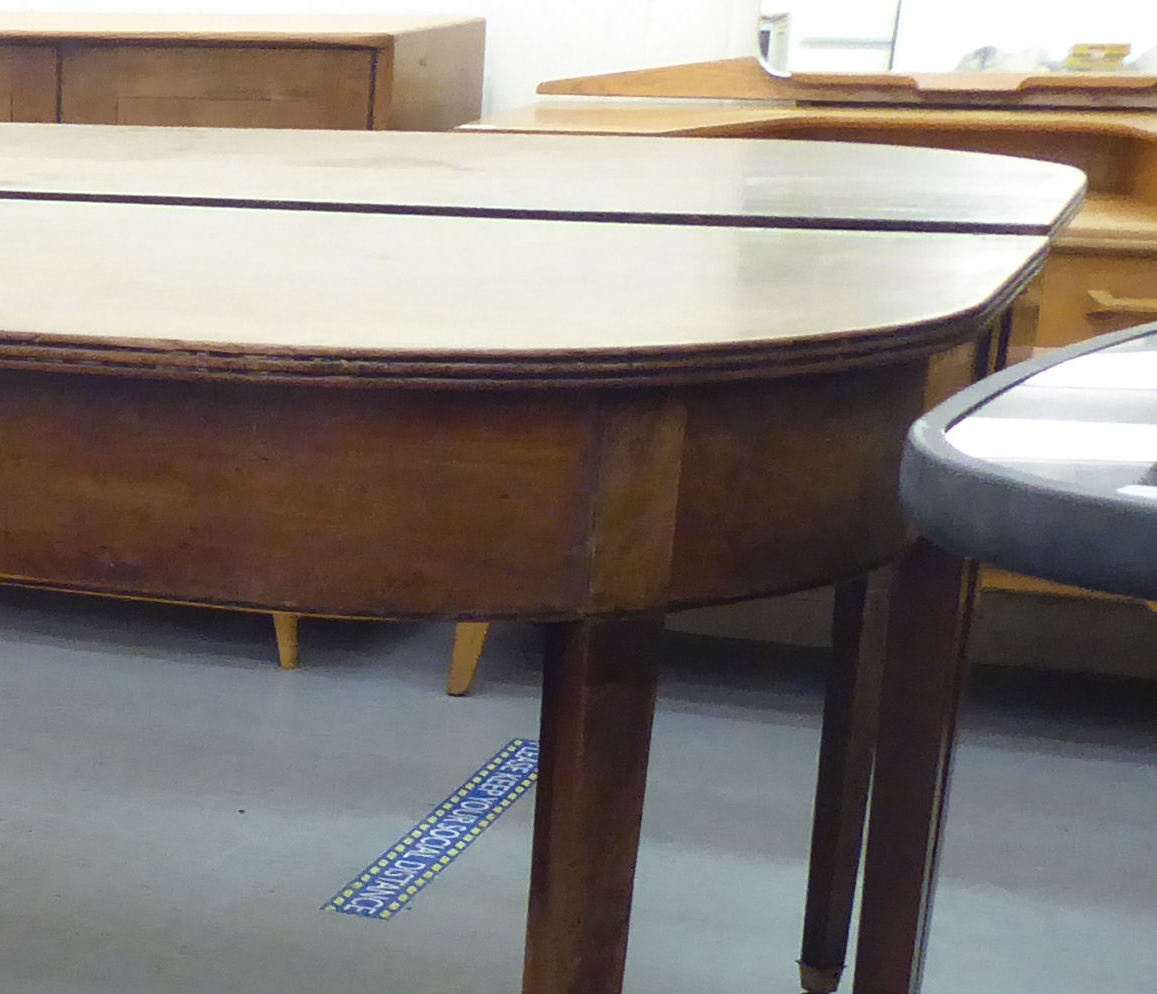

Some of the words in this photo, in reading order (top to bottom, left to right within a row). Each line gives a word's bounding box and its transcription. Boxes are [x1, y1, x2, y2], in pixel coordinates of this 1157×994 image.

[499, 741, 539, 773] LEASE
[477, 771, 522, 796] KEEP
[443, 796, 494, 827] YOUR
[404, 822, 467, 859] SOCIAL
[343, 860, 427, 915] DISTANCE
